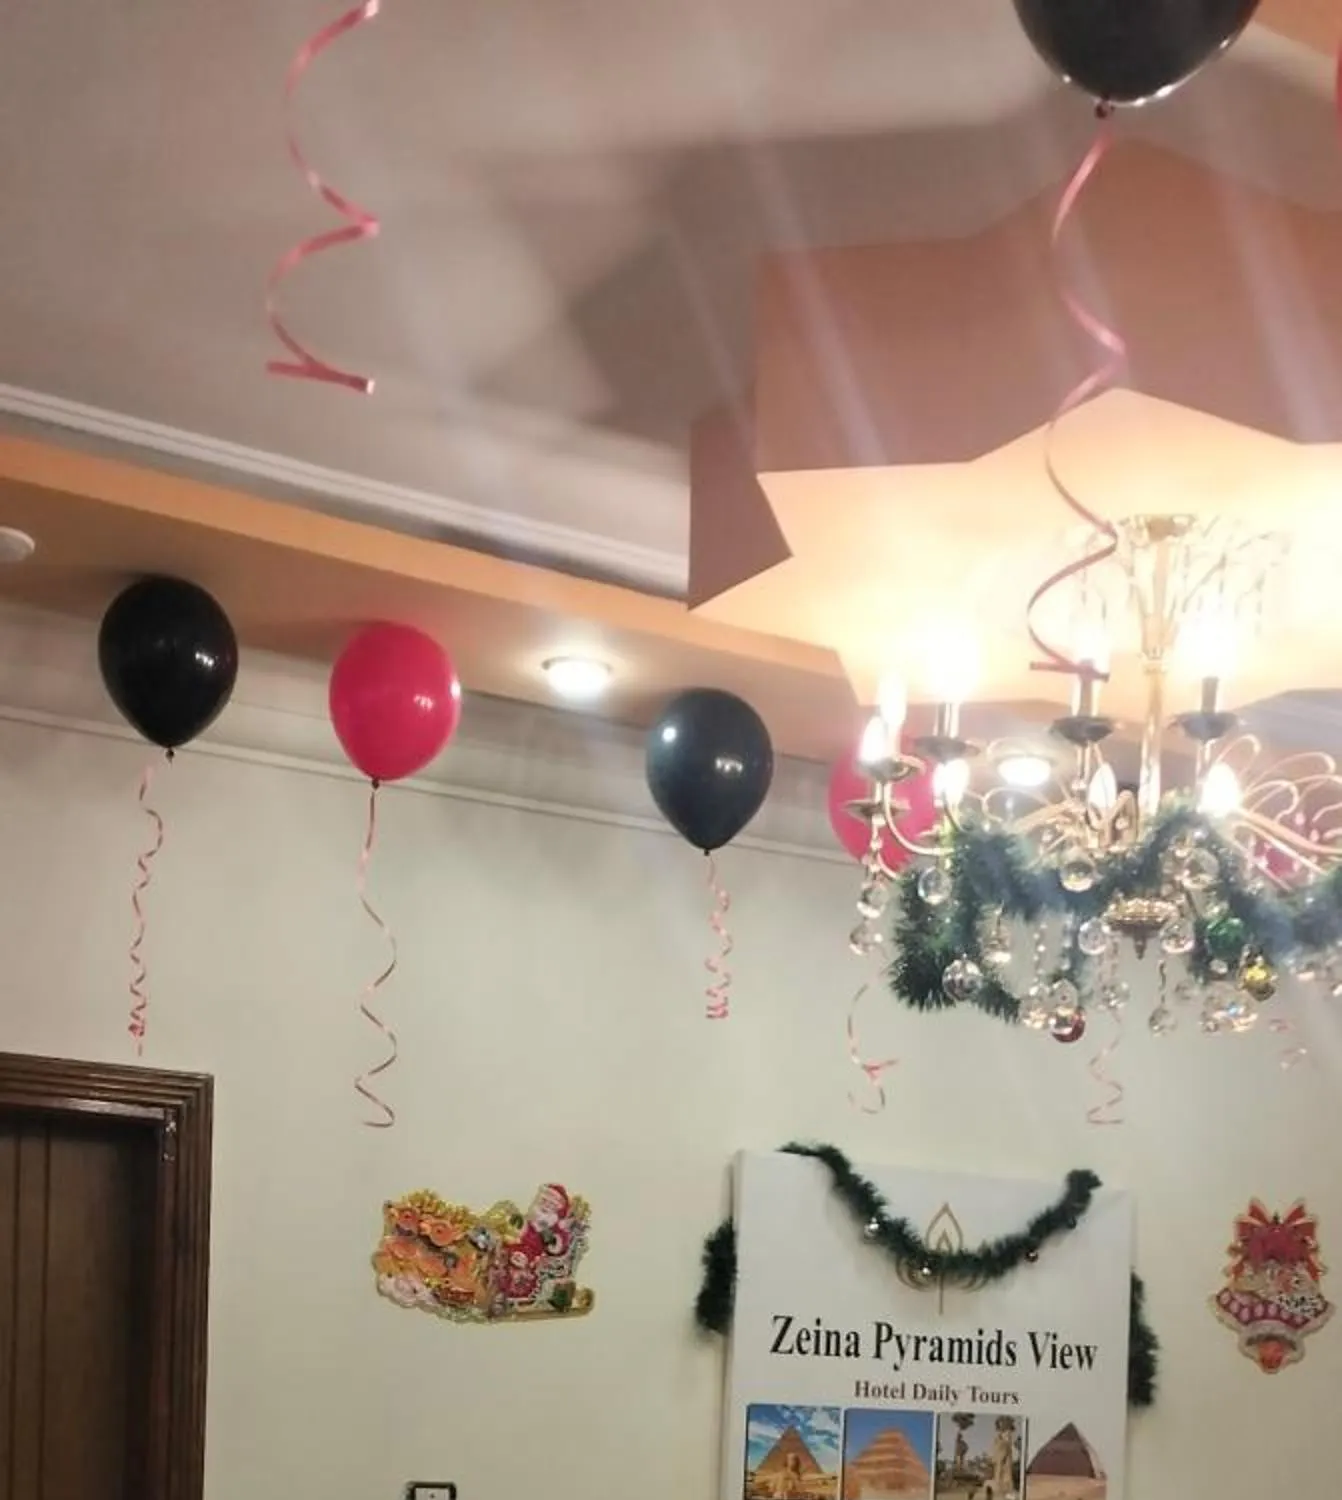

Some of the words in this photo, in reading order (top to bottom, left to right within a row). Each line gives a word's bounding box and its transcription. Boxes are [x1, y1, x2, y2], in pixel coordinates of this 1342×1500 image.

[770, 1314, 861, 1359] Zeina
[872, 1321, 1018, 1371] Pyramids
[1027, 1331, 1098, 1371] View
[854, 1380, 906, 1400] Hotel
[913, 1383, 959, 1405] Daily
[967, 1385, 1021, 1405] Tours
